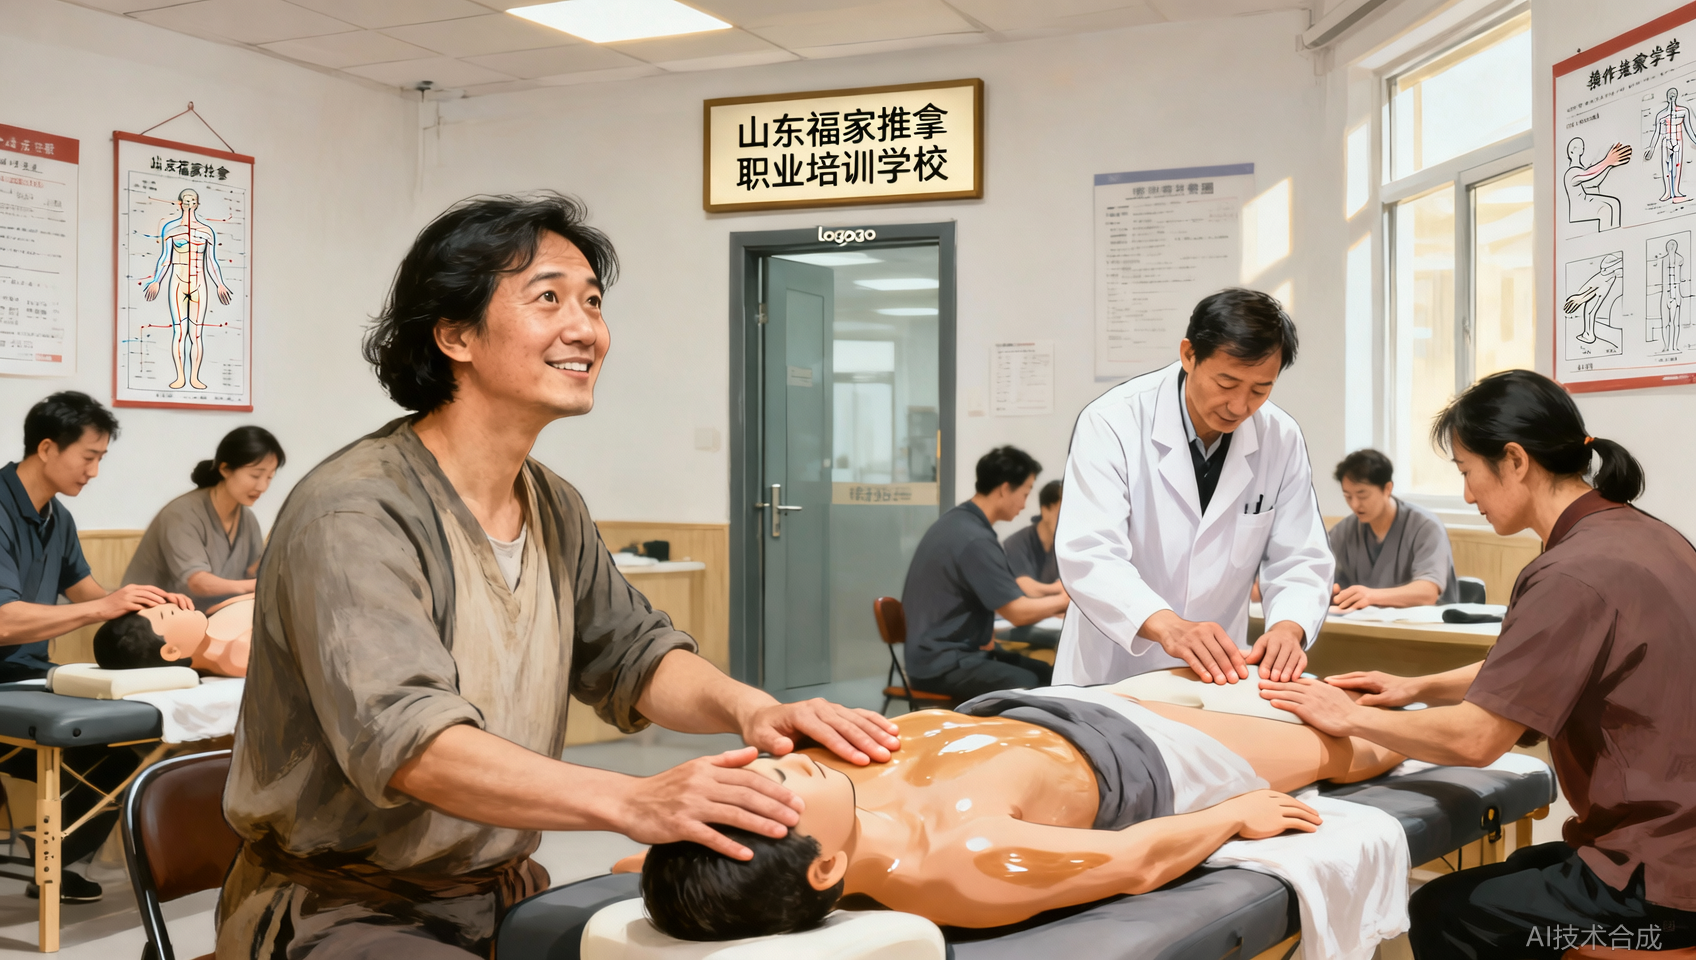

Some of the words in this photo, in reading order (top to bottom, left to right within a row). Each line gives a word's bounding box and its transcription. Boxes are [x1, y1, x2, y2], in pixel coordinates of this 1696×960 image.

[738, 102, 949, 148] 山东福家推拿
[736, 144, 949, 191] 职业培训学校
